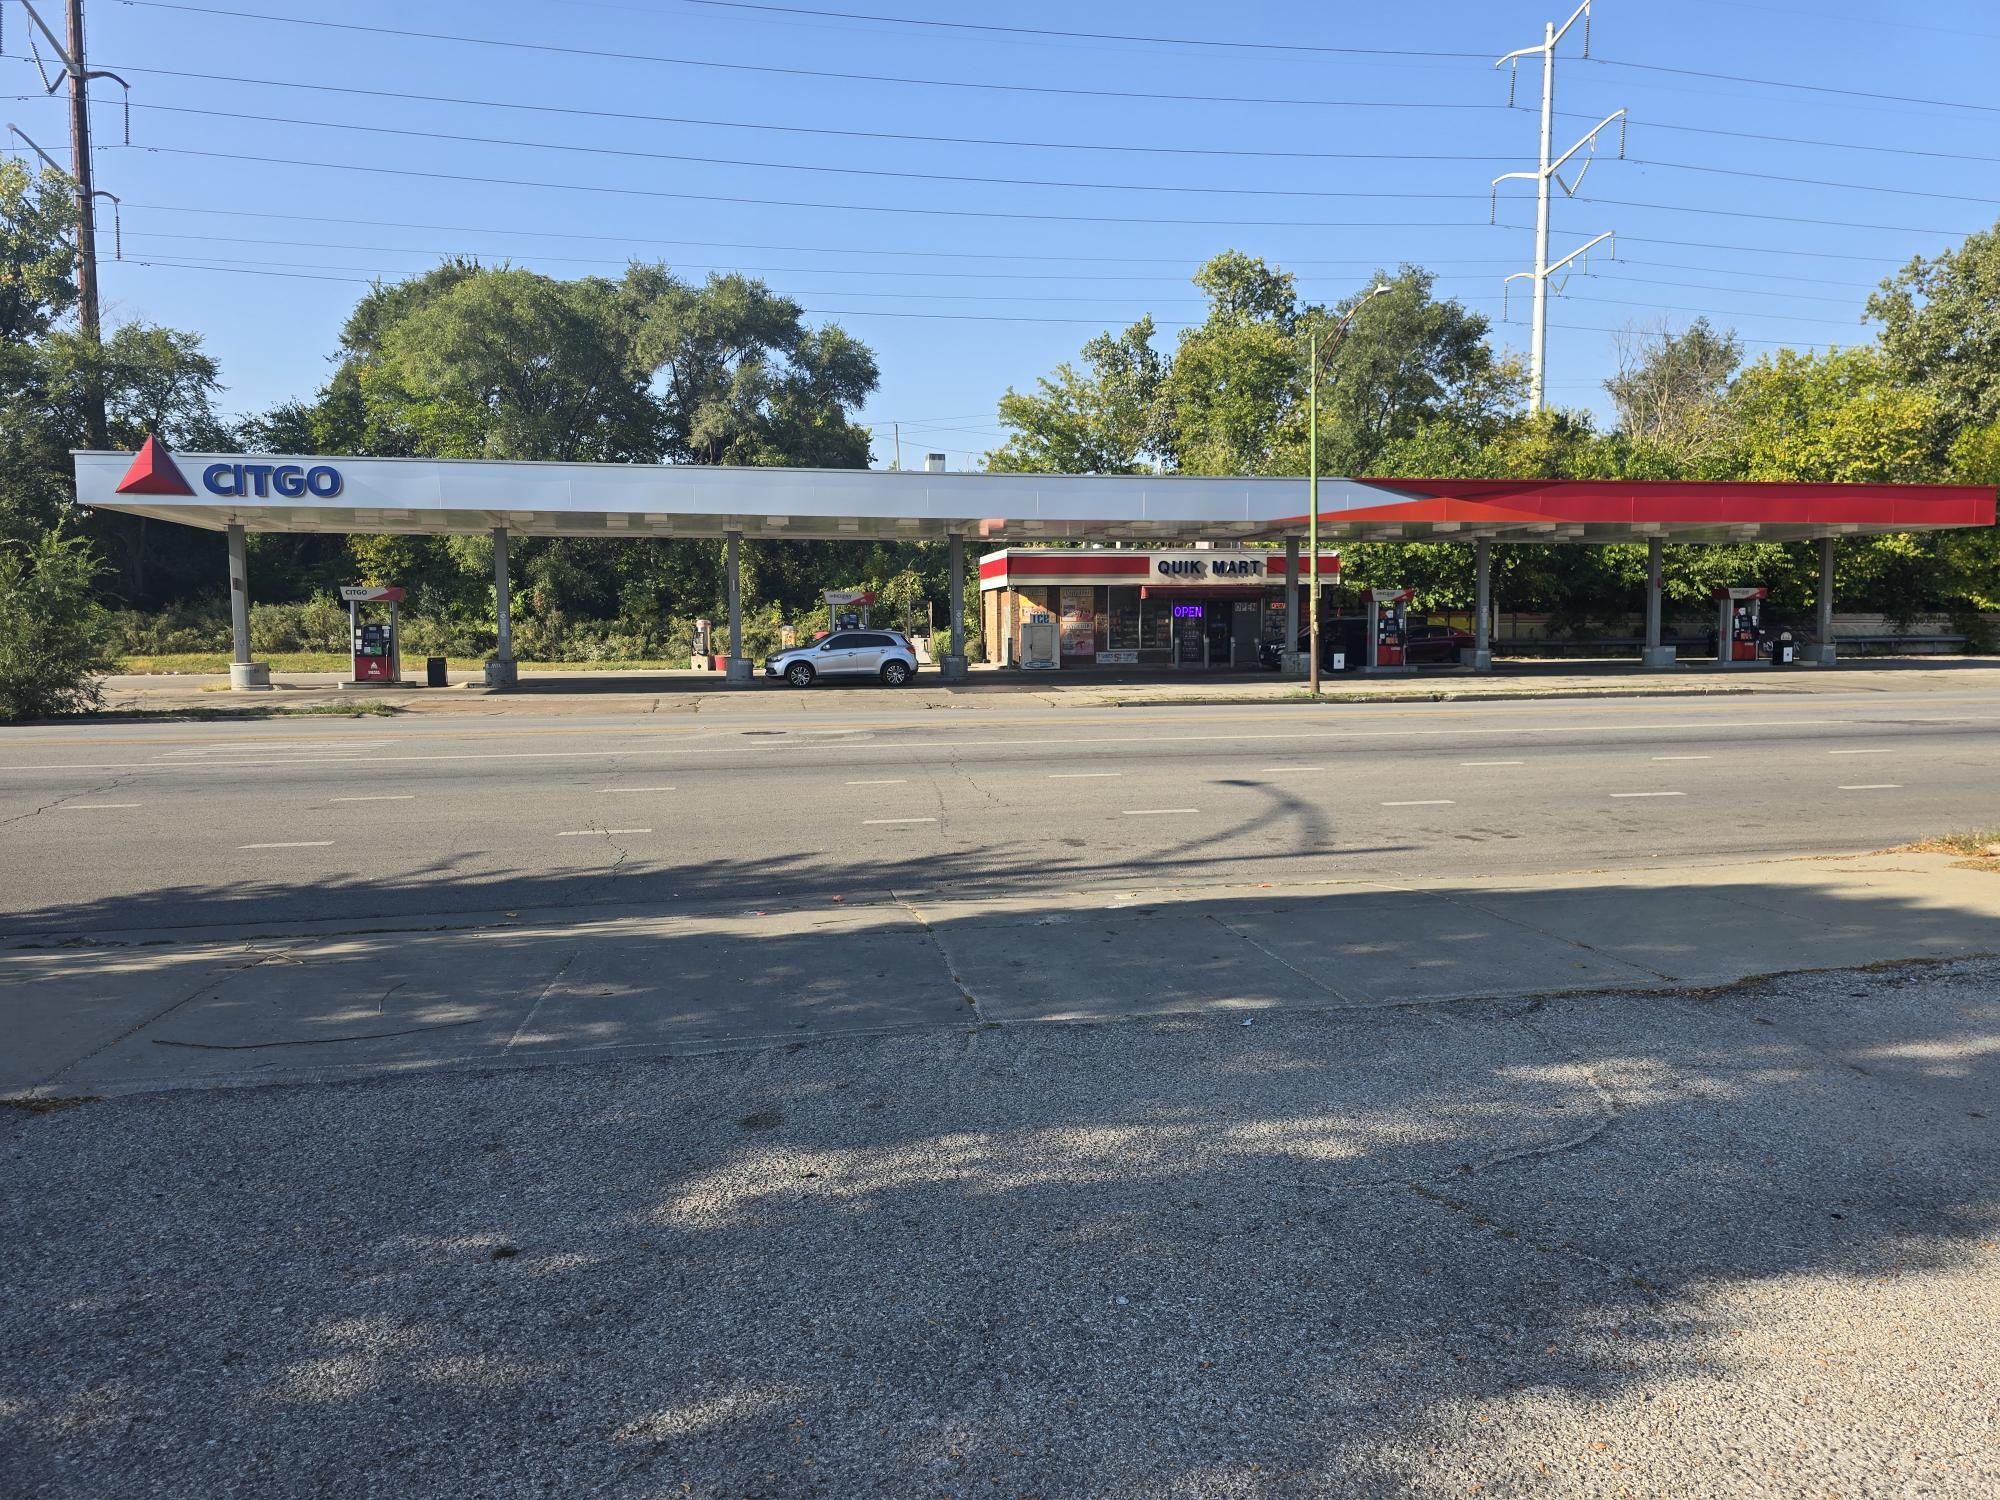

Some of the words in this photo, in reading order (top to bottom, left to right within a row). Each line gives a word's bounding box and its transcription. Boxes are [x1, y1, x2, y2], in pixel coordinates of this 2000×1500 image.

[203, 463, 343, 498] CITGO
[1158, 560, 1201, 574] QUIK
[1212, 560, 1260, 574] MART
[1174, 605, 1203, 618] OPEN
[1234, 602, 1257, 612] OPEN
[1032, 614, 1050, 624] ICE
